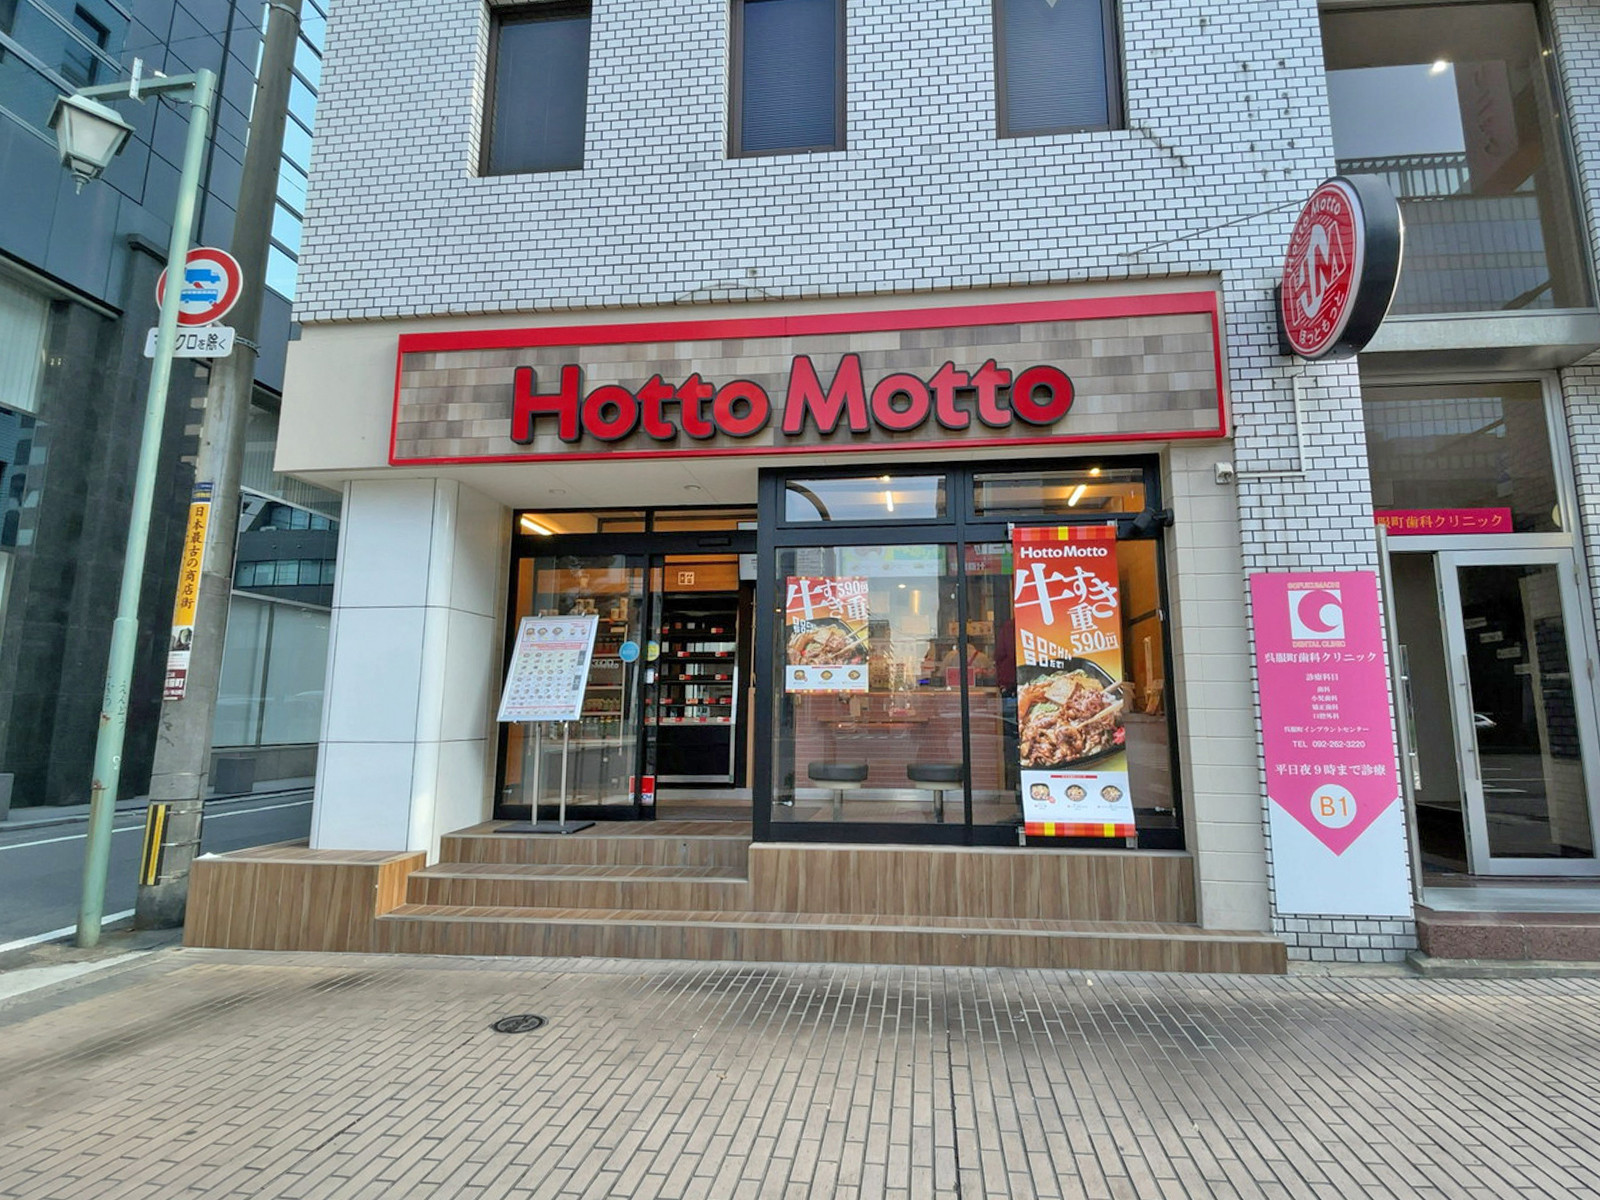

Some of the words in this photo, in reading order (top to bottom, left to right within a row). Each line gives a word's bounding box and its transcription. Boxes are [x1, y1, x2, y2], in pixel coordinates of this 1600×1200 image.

[1310, 197, 1341, 216] Motto
[154, 333, 226, 351] クロを除く
[510, 363, 771, 444] Hotto
[782, 353, 1075, 435] Motto
[180, 506, 205, 610] 日本最古の商店街
[1264, 651, 1378, 664] 呉服町歯科クリニック
[1292, 740, 1308, 748] TEL
[1319, 795, 1349, 817] B1
